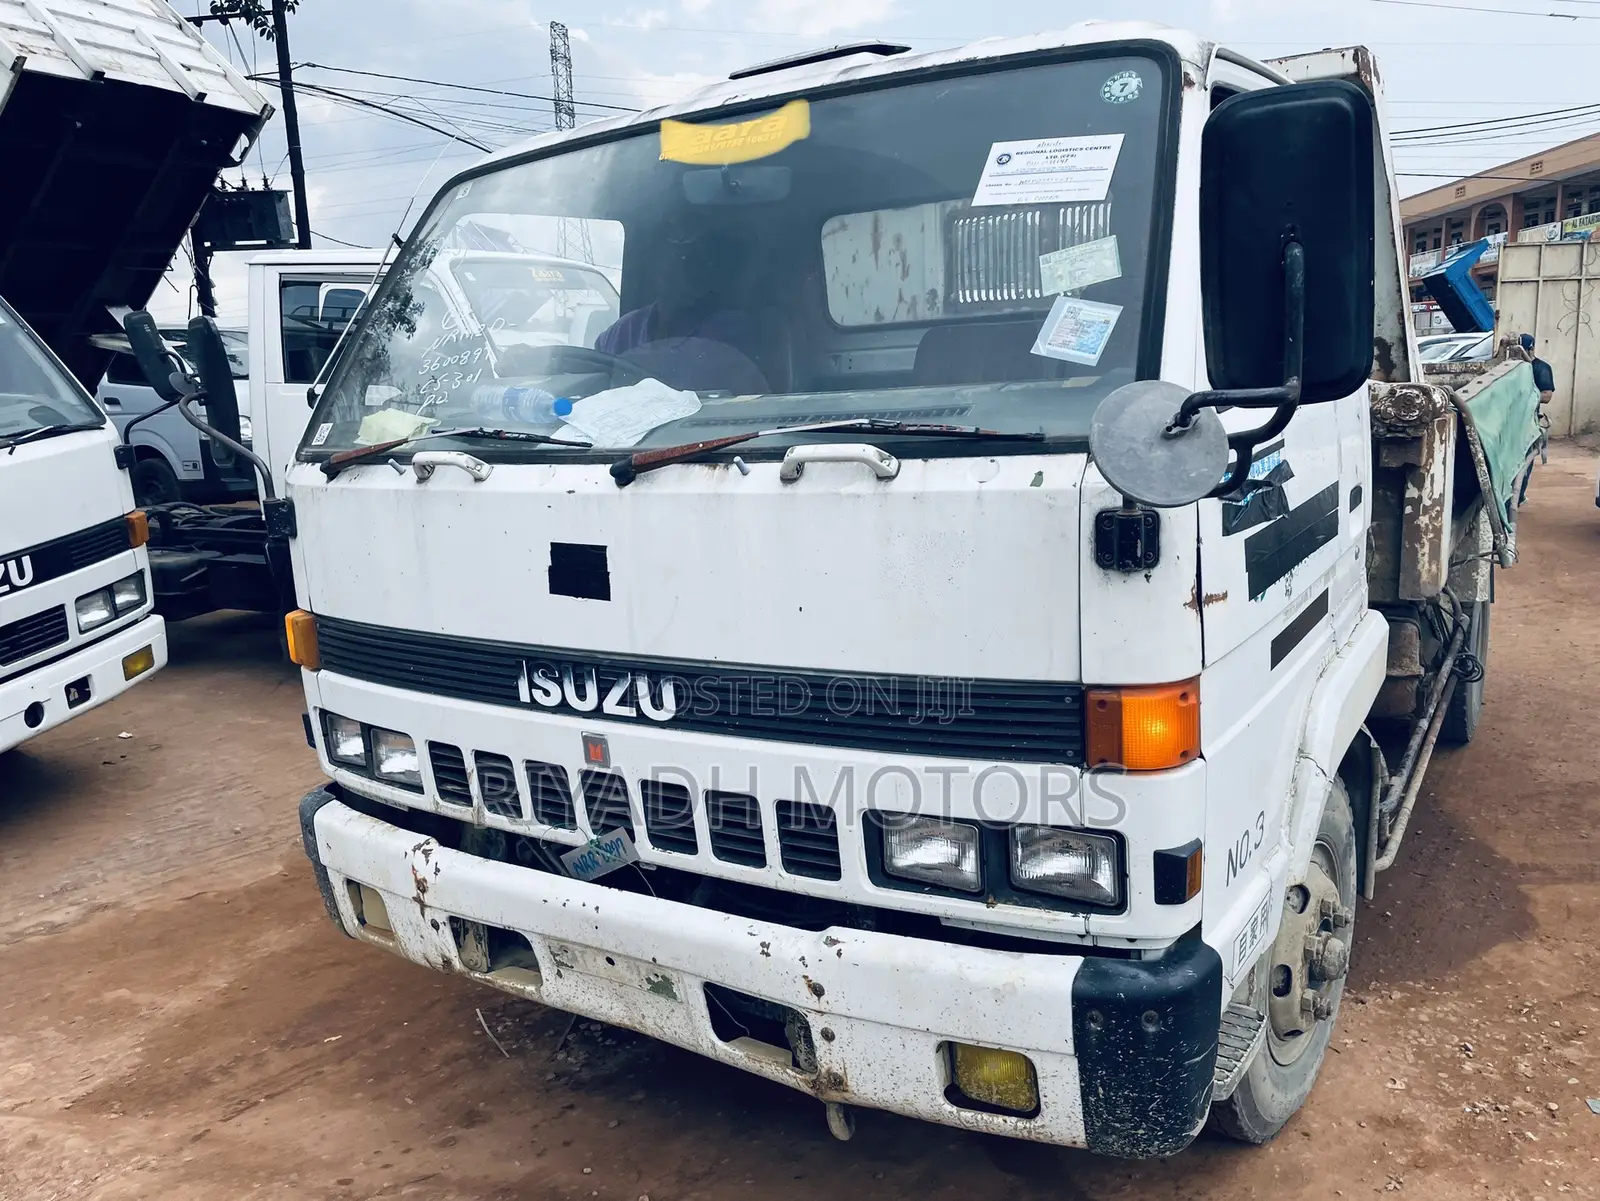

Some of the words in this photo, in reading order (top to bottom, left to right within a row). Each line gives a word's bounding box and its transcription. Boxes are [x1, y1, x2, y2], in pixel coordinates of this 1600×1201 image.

[1119, 82, 1129, 93] 7
[669, 116, 788, 148] aara
[517, 659, 678, 722] ISUZU
[1237, 900, 1270, 967] 自家用
